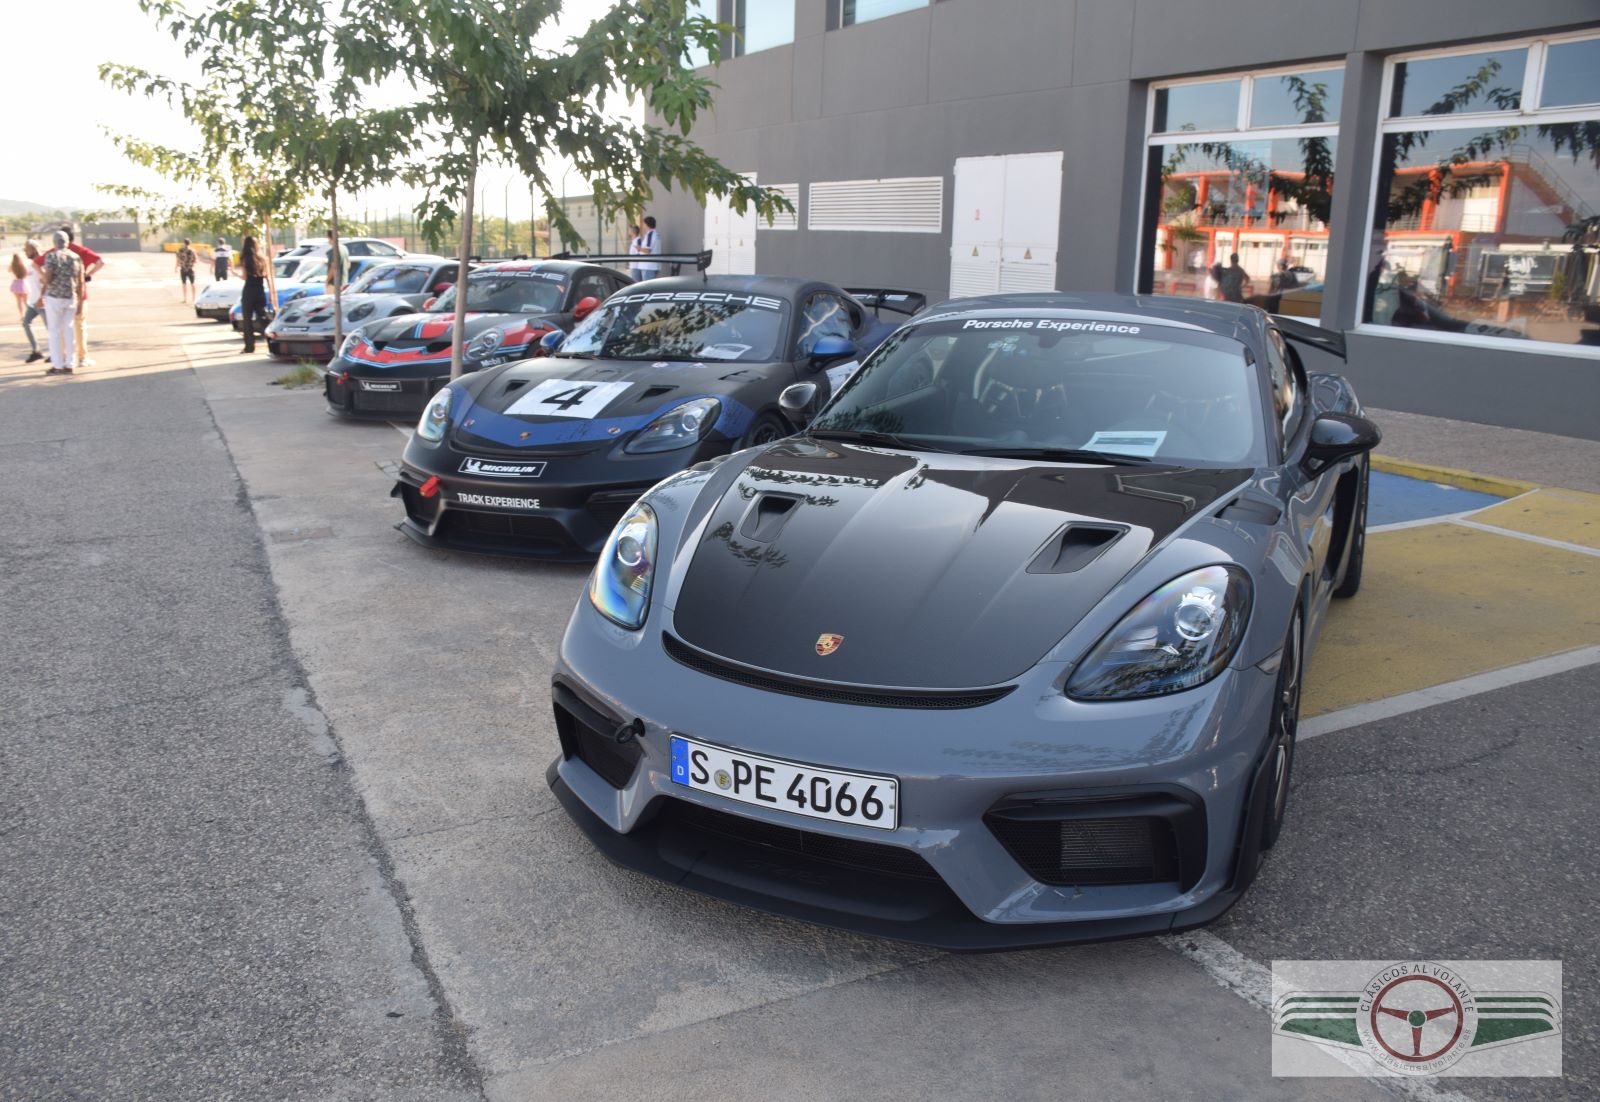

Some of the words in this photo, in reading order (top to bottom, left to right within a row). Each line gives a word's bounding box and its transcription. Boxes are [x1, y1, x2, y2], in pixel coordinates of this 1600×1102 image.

[604, 292, 781, 310] PORSCHE
[962, 318, 1034, 330] Porsche
[1036, 319, 1141, 335] Experience
[541, 385, 597, 410] 4
[480, 464, 537, 473] MICHELIN
[456, 492, 484, 505] TRACK
[484, 495, 541, 509] EXPERIENCE
[676, 765, 684, 776] D
[690, 749, 710, 785] S
[731, 758, 777, 804] PE
[786, 773, 884, 821] 4066
